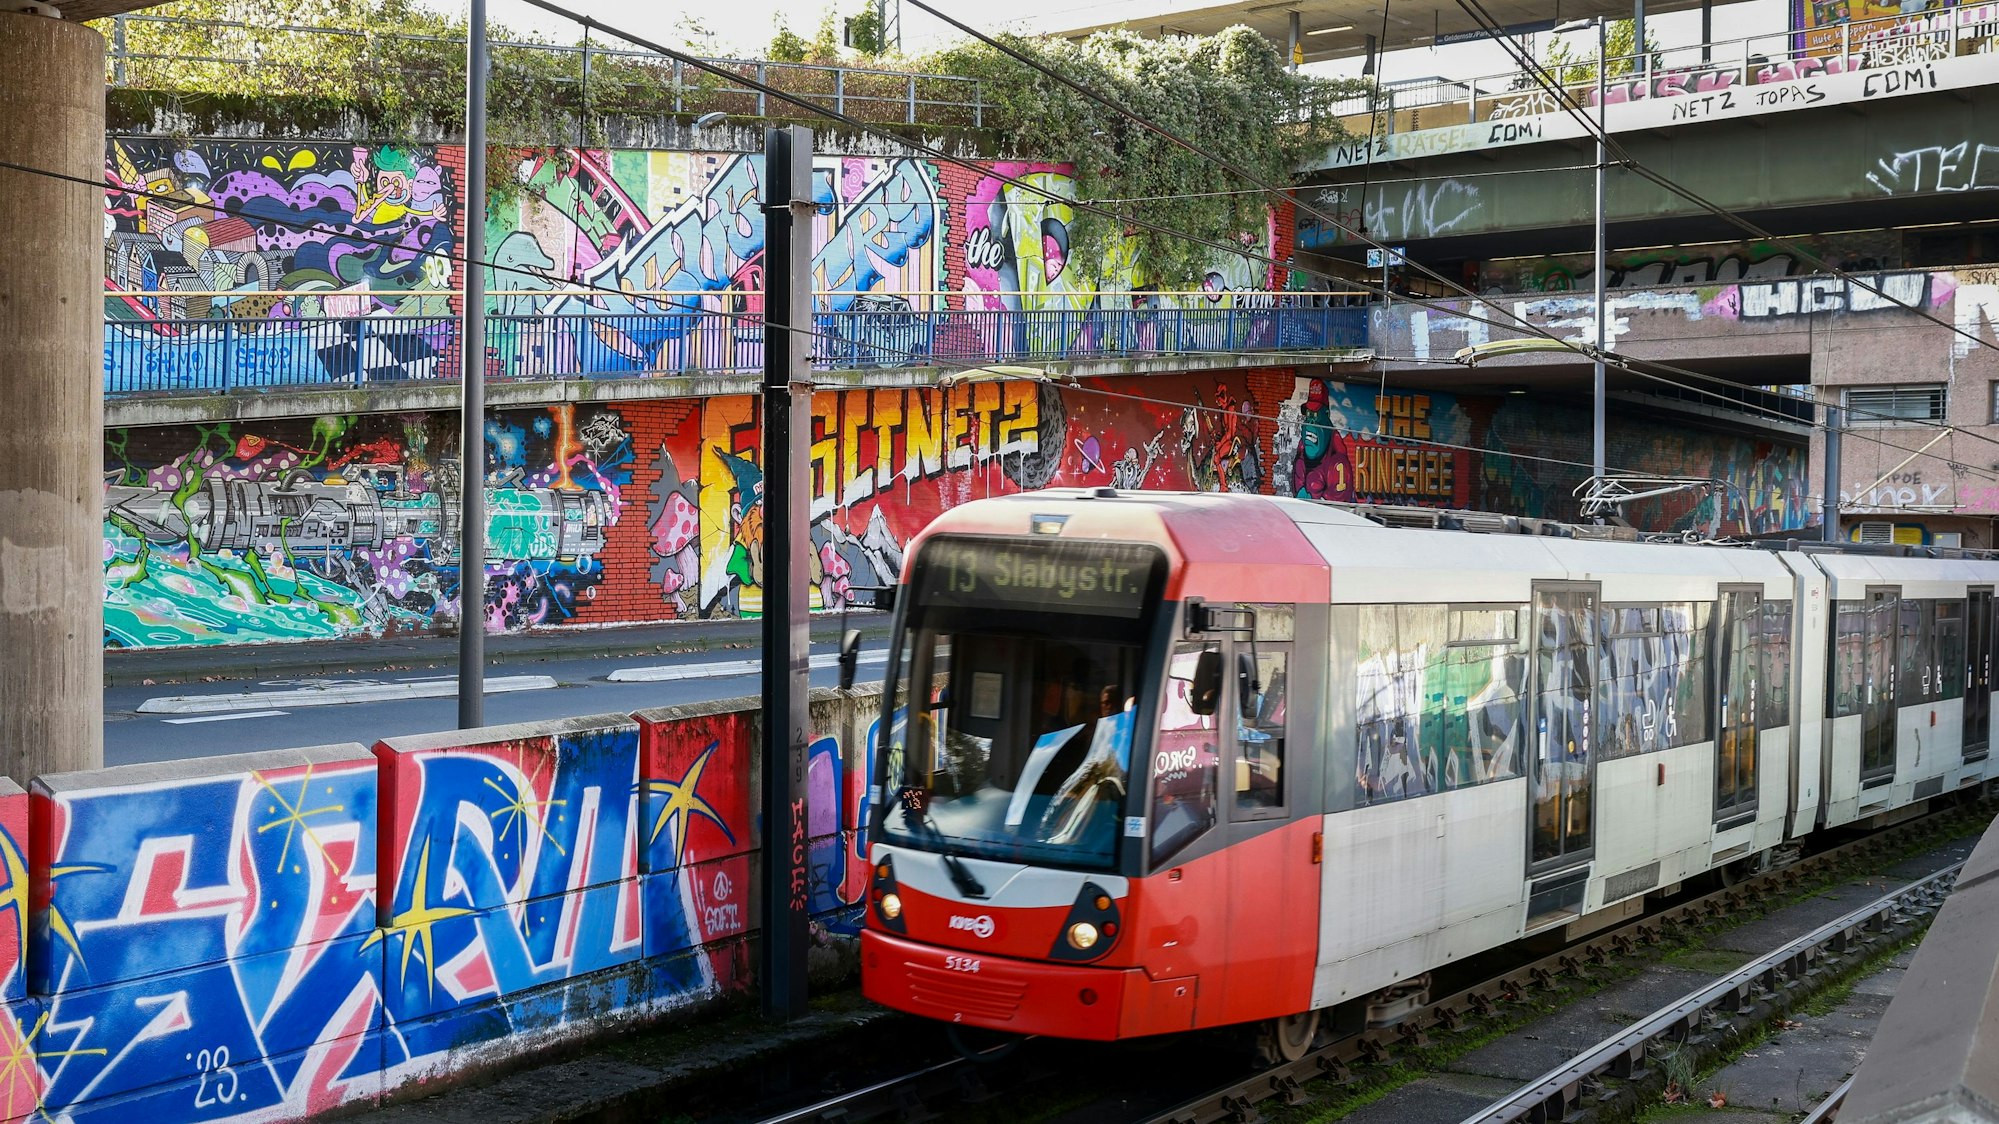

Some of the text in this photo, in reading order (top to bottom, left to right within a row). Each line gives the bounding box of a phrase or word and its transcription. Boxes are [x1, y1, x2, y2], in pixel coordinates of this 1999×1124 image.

[1672, 91, 1736, 121] NETZ
[966, 227, 1003, 269] the
[1375, 395, 1432, 440] THE
[1355, 446, 1454, 495] KINGSIZE
[948, 549, 1138, 599] 13 Slabystr.
[945, 955, 981, 974] 5134
[953, 1012, 963, 1023] 2
